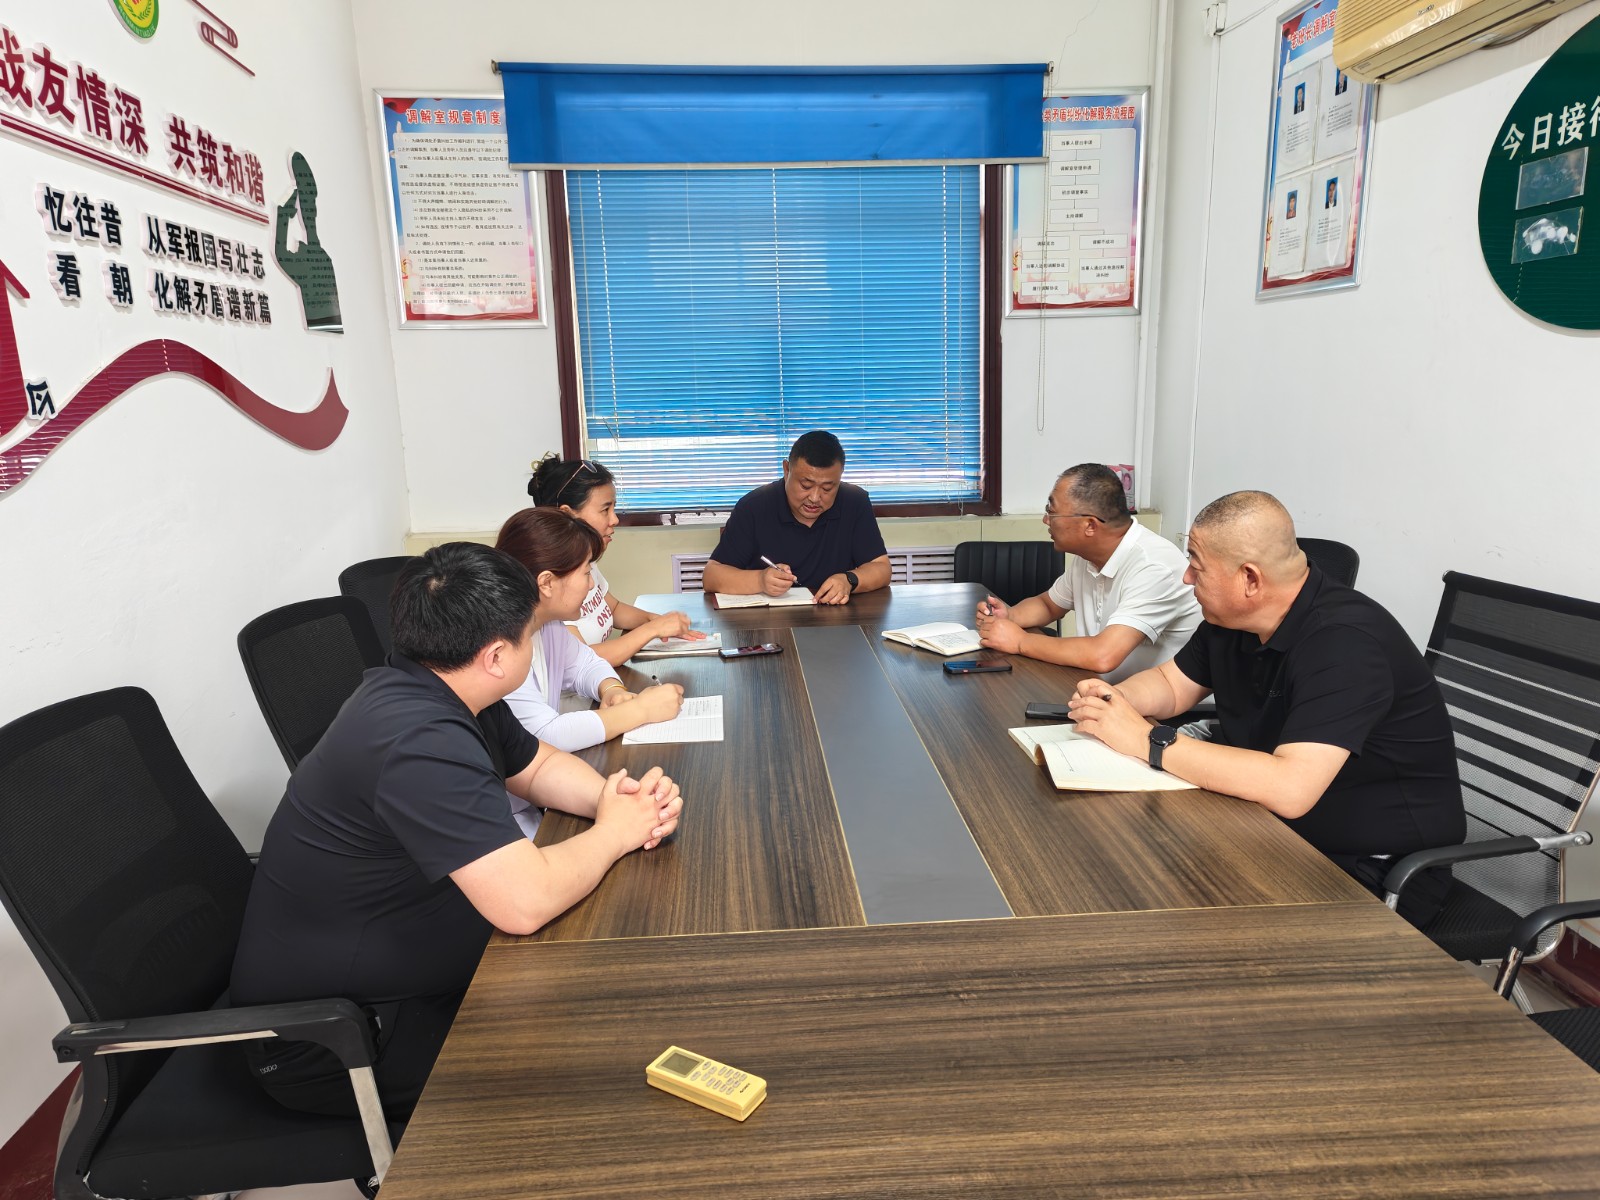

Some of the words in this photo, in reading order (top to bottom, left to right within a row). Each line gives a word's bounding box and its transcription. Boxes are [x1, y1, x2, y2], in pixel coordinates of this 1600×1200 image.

[0, 27, 148, 154] 战友情深
[169, 116, 266, 206] 共筑和谐
[405, 108, 501, 125] 调解室规章制度
[45, 186, 122, 246] 忆往昔
[147, 215, 266, 280] 从军报国写壮志
[56, 253, 81, 298] 看
[109, 263, 133, 306] 朝
[154, 271, 272, 324] 化解矛盾谱新篇
[597, 605, 612, 627] ONE
